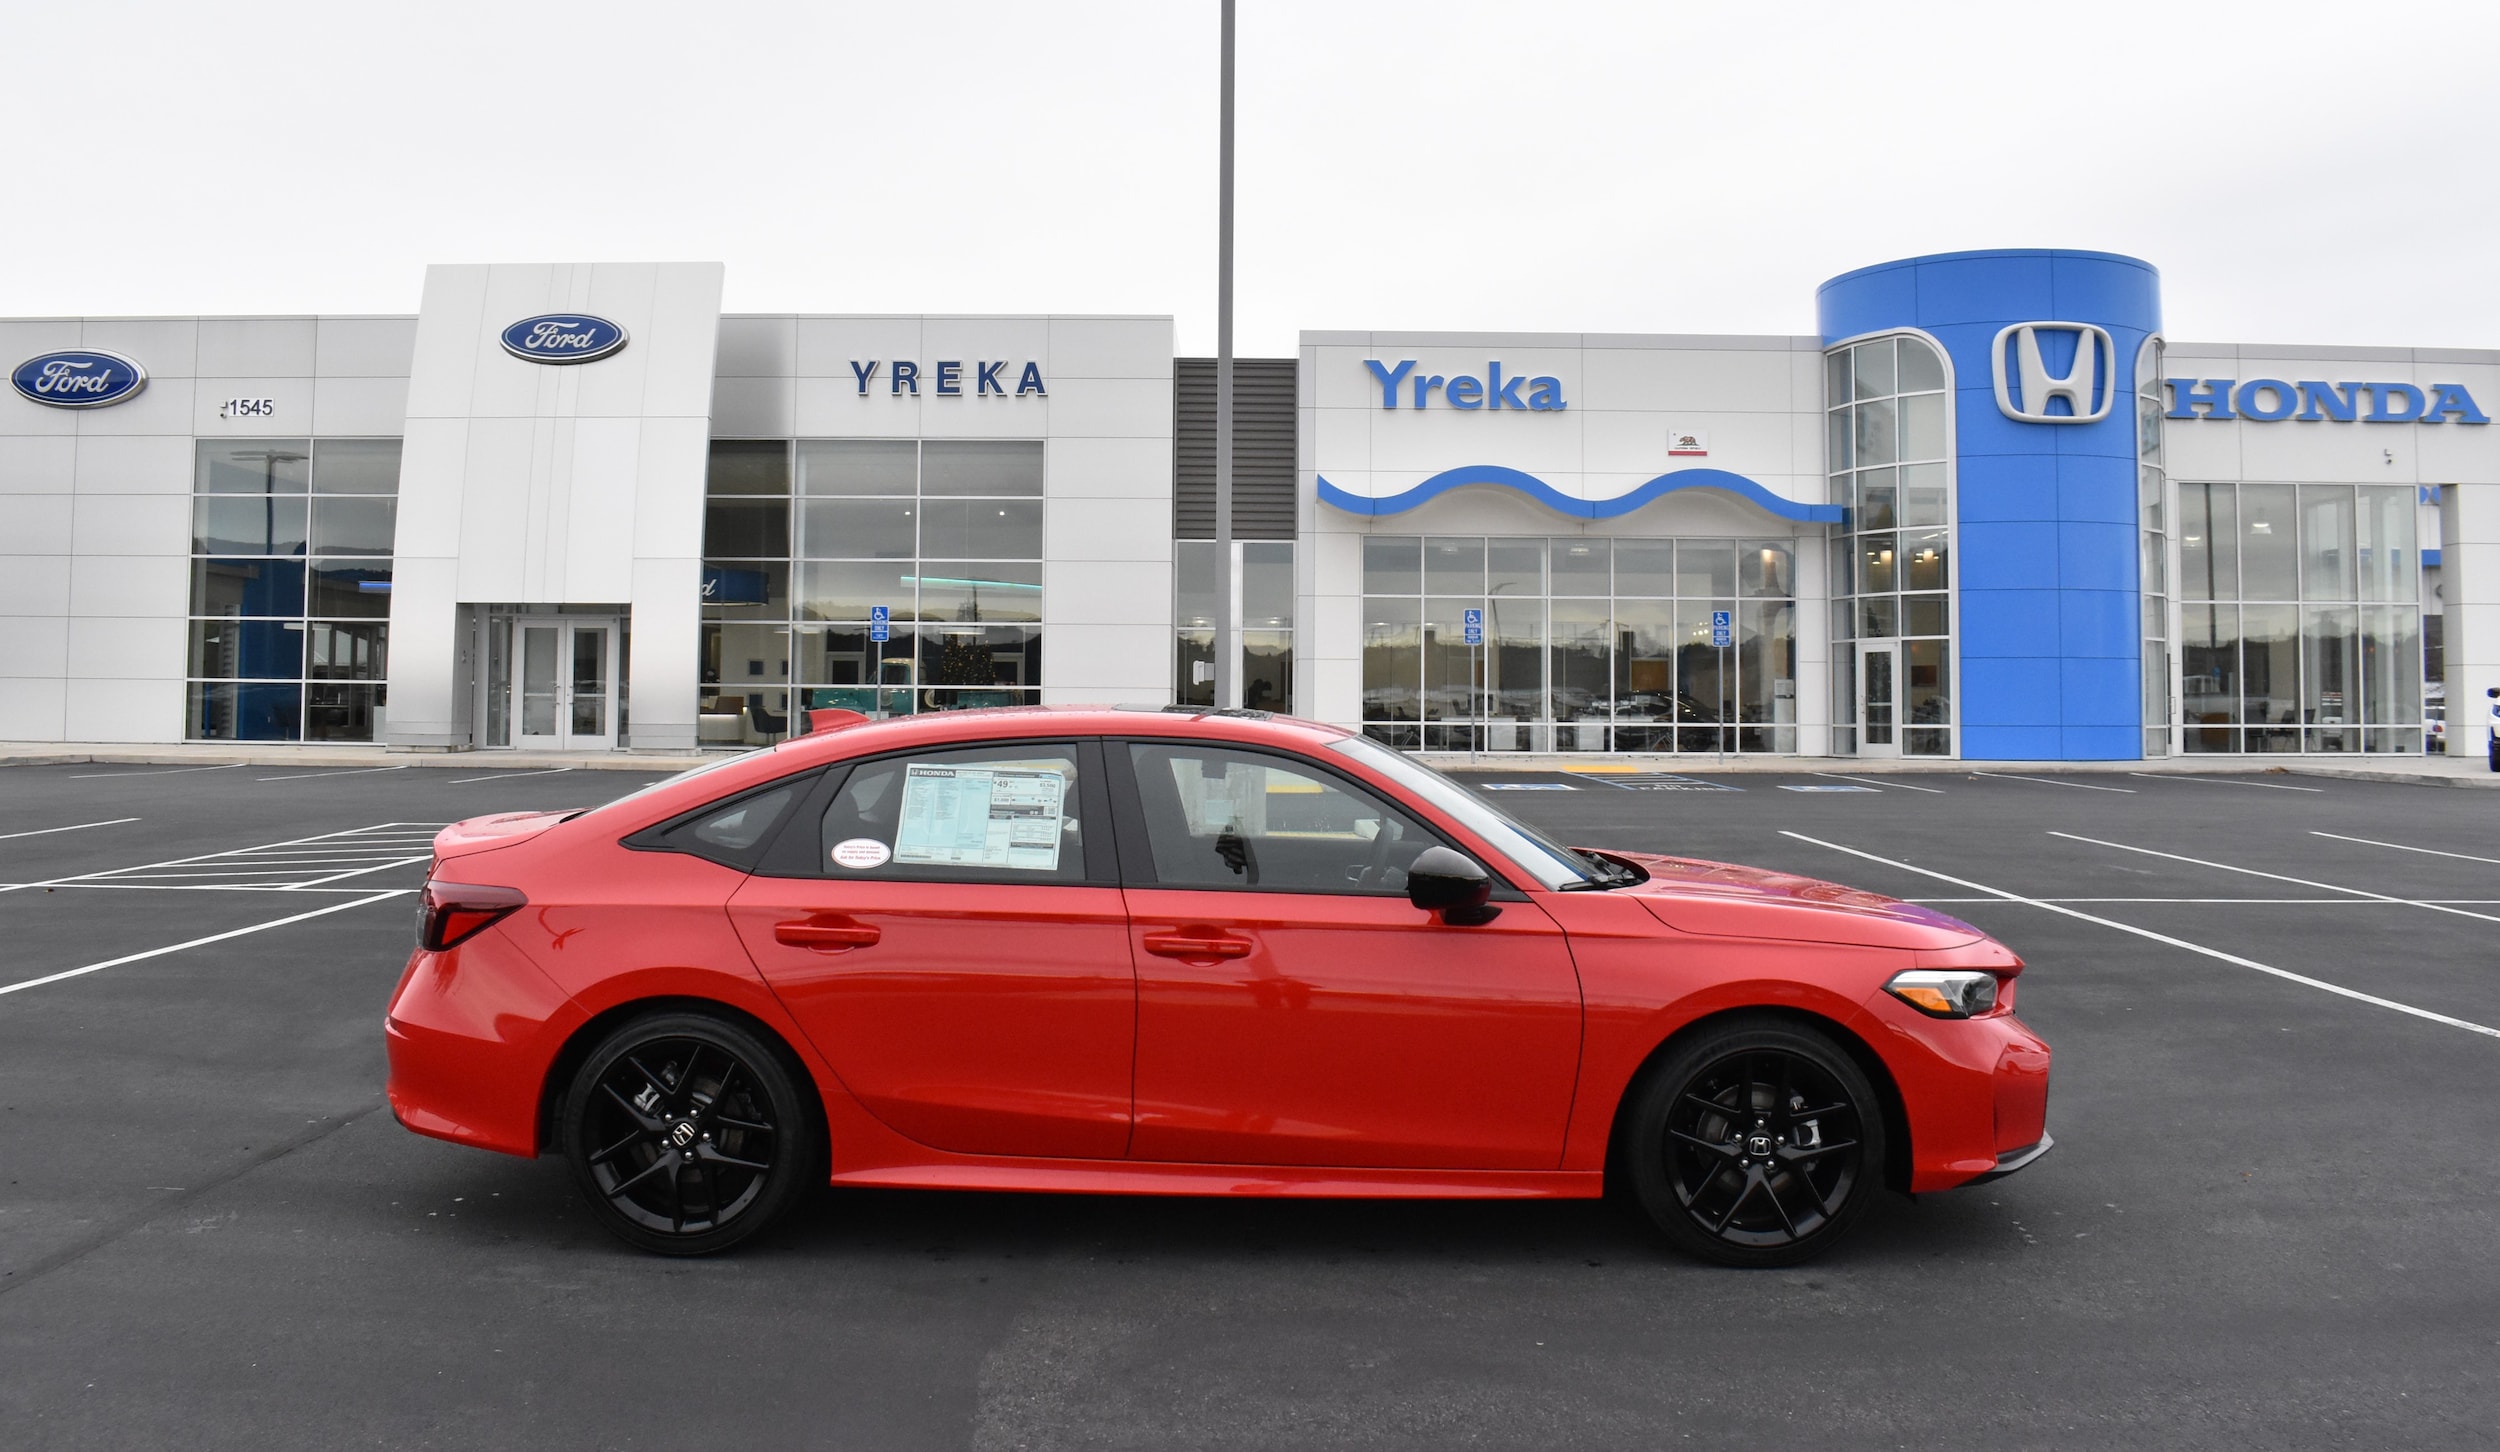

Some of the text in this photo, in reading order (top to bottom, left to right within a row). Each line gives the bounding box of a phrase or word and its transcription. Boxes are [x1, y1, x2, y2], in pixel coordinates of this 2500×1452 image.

[525, 321, 597, 349] Ford
[35, 360, 111, 393] Ford
[850, 360, 1047, 396] YREKA
[1363, 359, 1568, 411] Yreka
[230, 399, 273, 416] 1545
[2165, 378, 2491, 424] HONDA
[918, 769, 955, 777] HONDA
